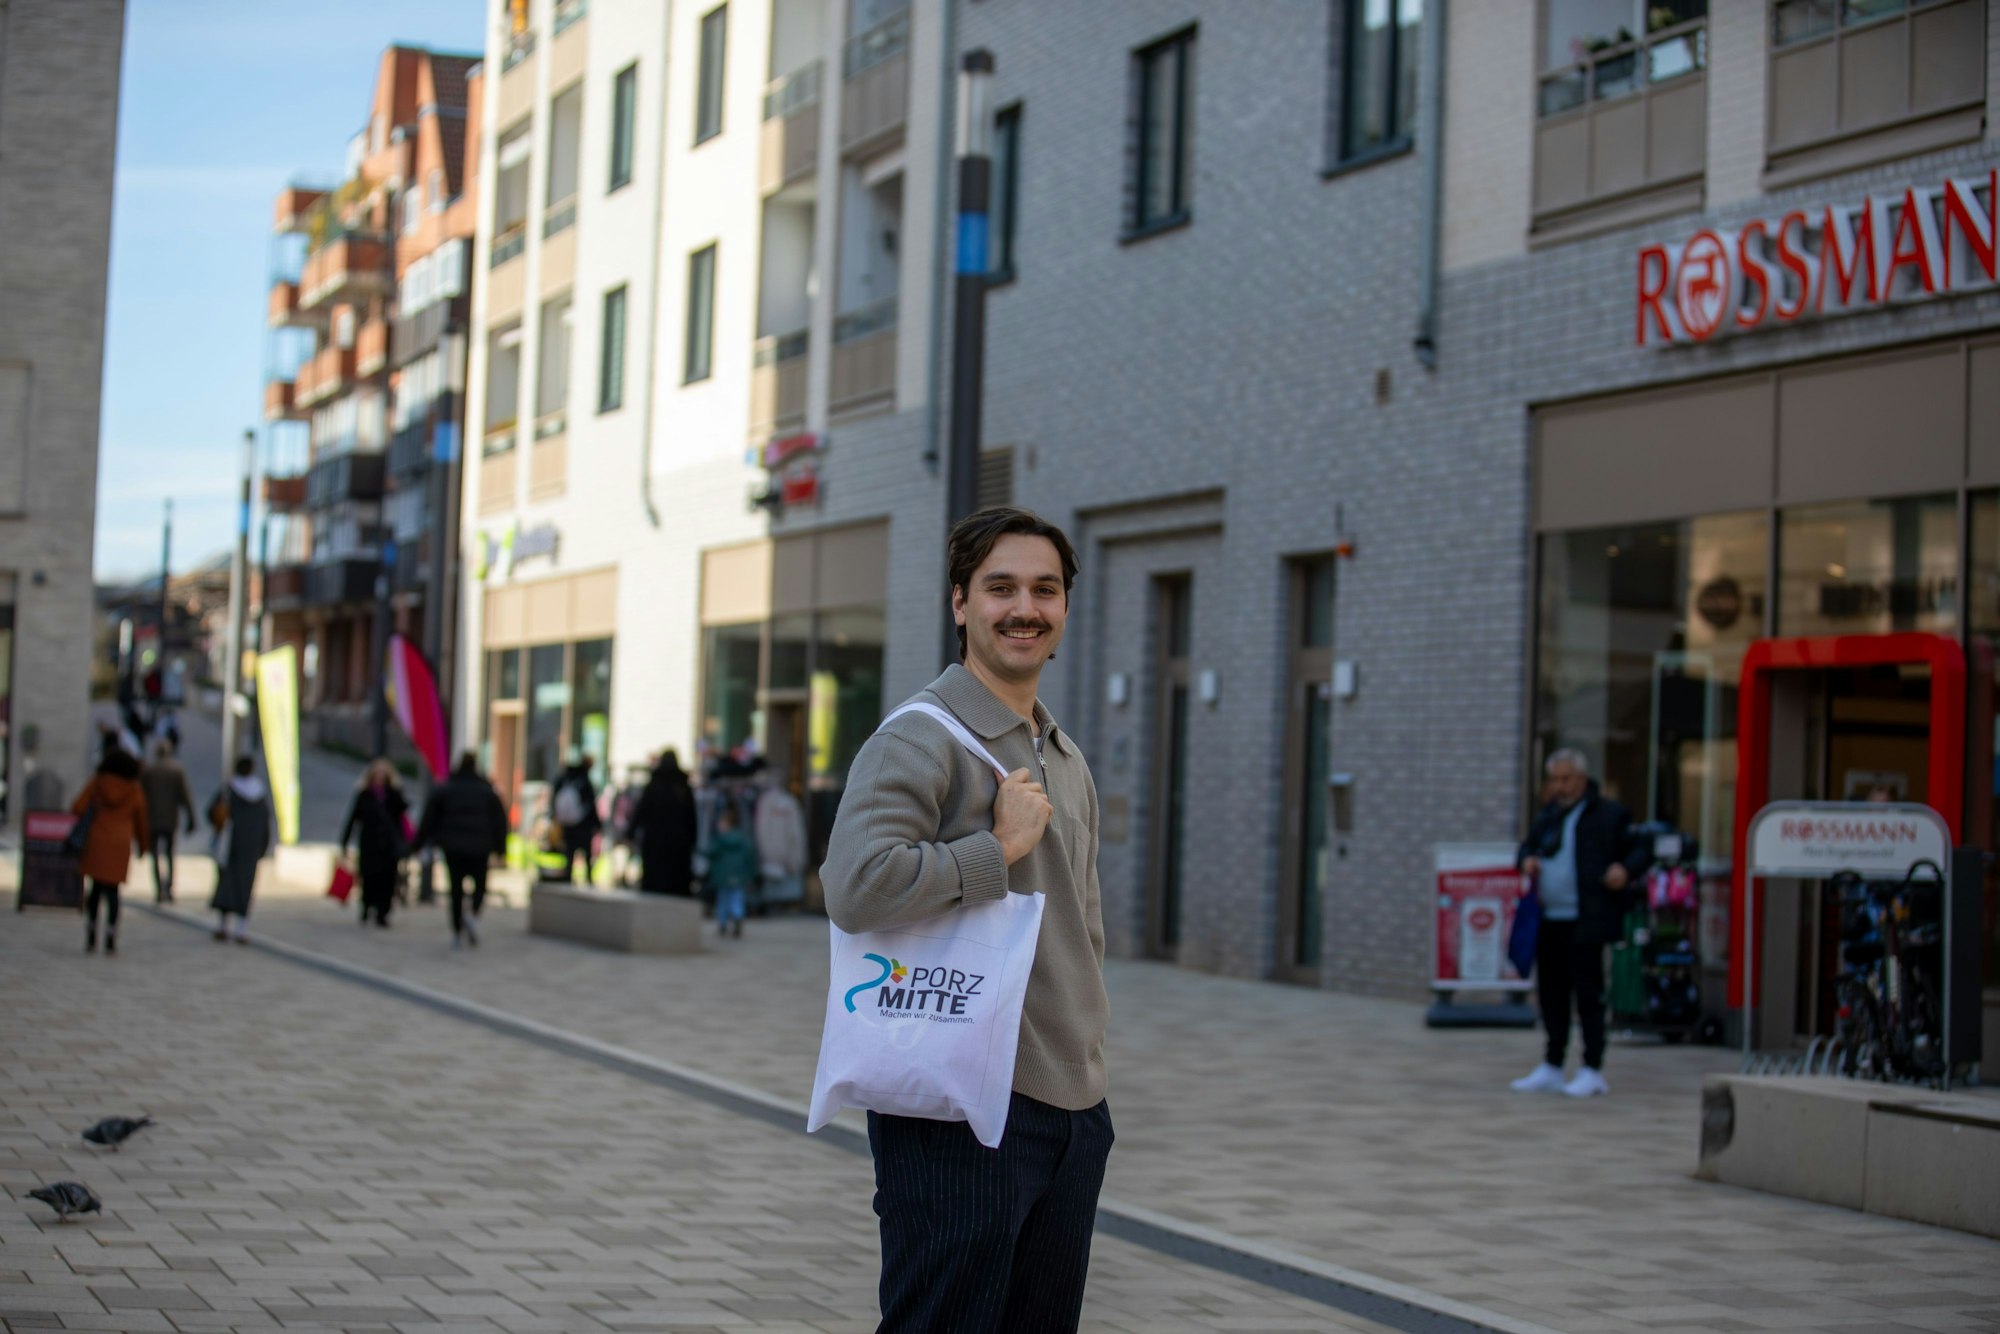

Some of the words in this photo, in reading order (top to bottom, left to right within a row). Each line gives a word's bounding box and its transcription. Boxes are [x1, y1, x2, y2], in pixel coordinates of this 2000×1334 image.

[1781, 819, 1917, 842] ROSSMANN
[911, 967, 985, 994] PORZ
[877, 986, 968, 1014] MITTE
[879, 1009, 911, 1019] Machen
[928, 1013, 975, 1024] zusammen.
